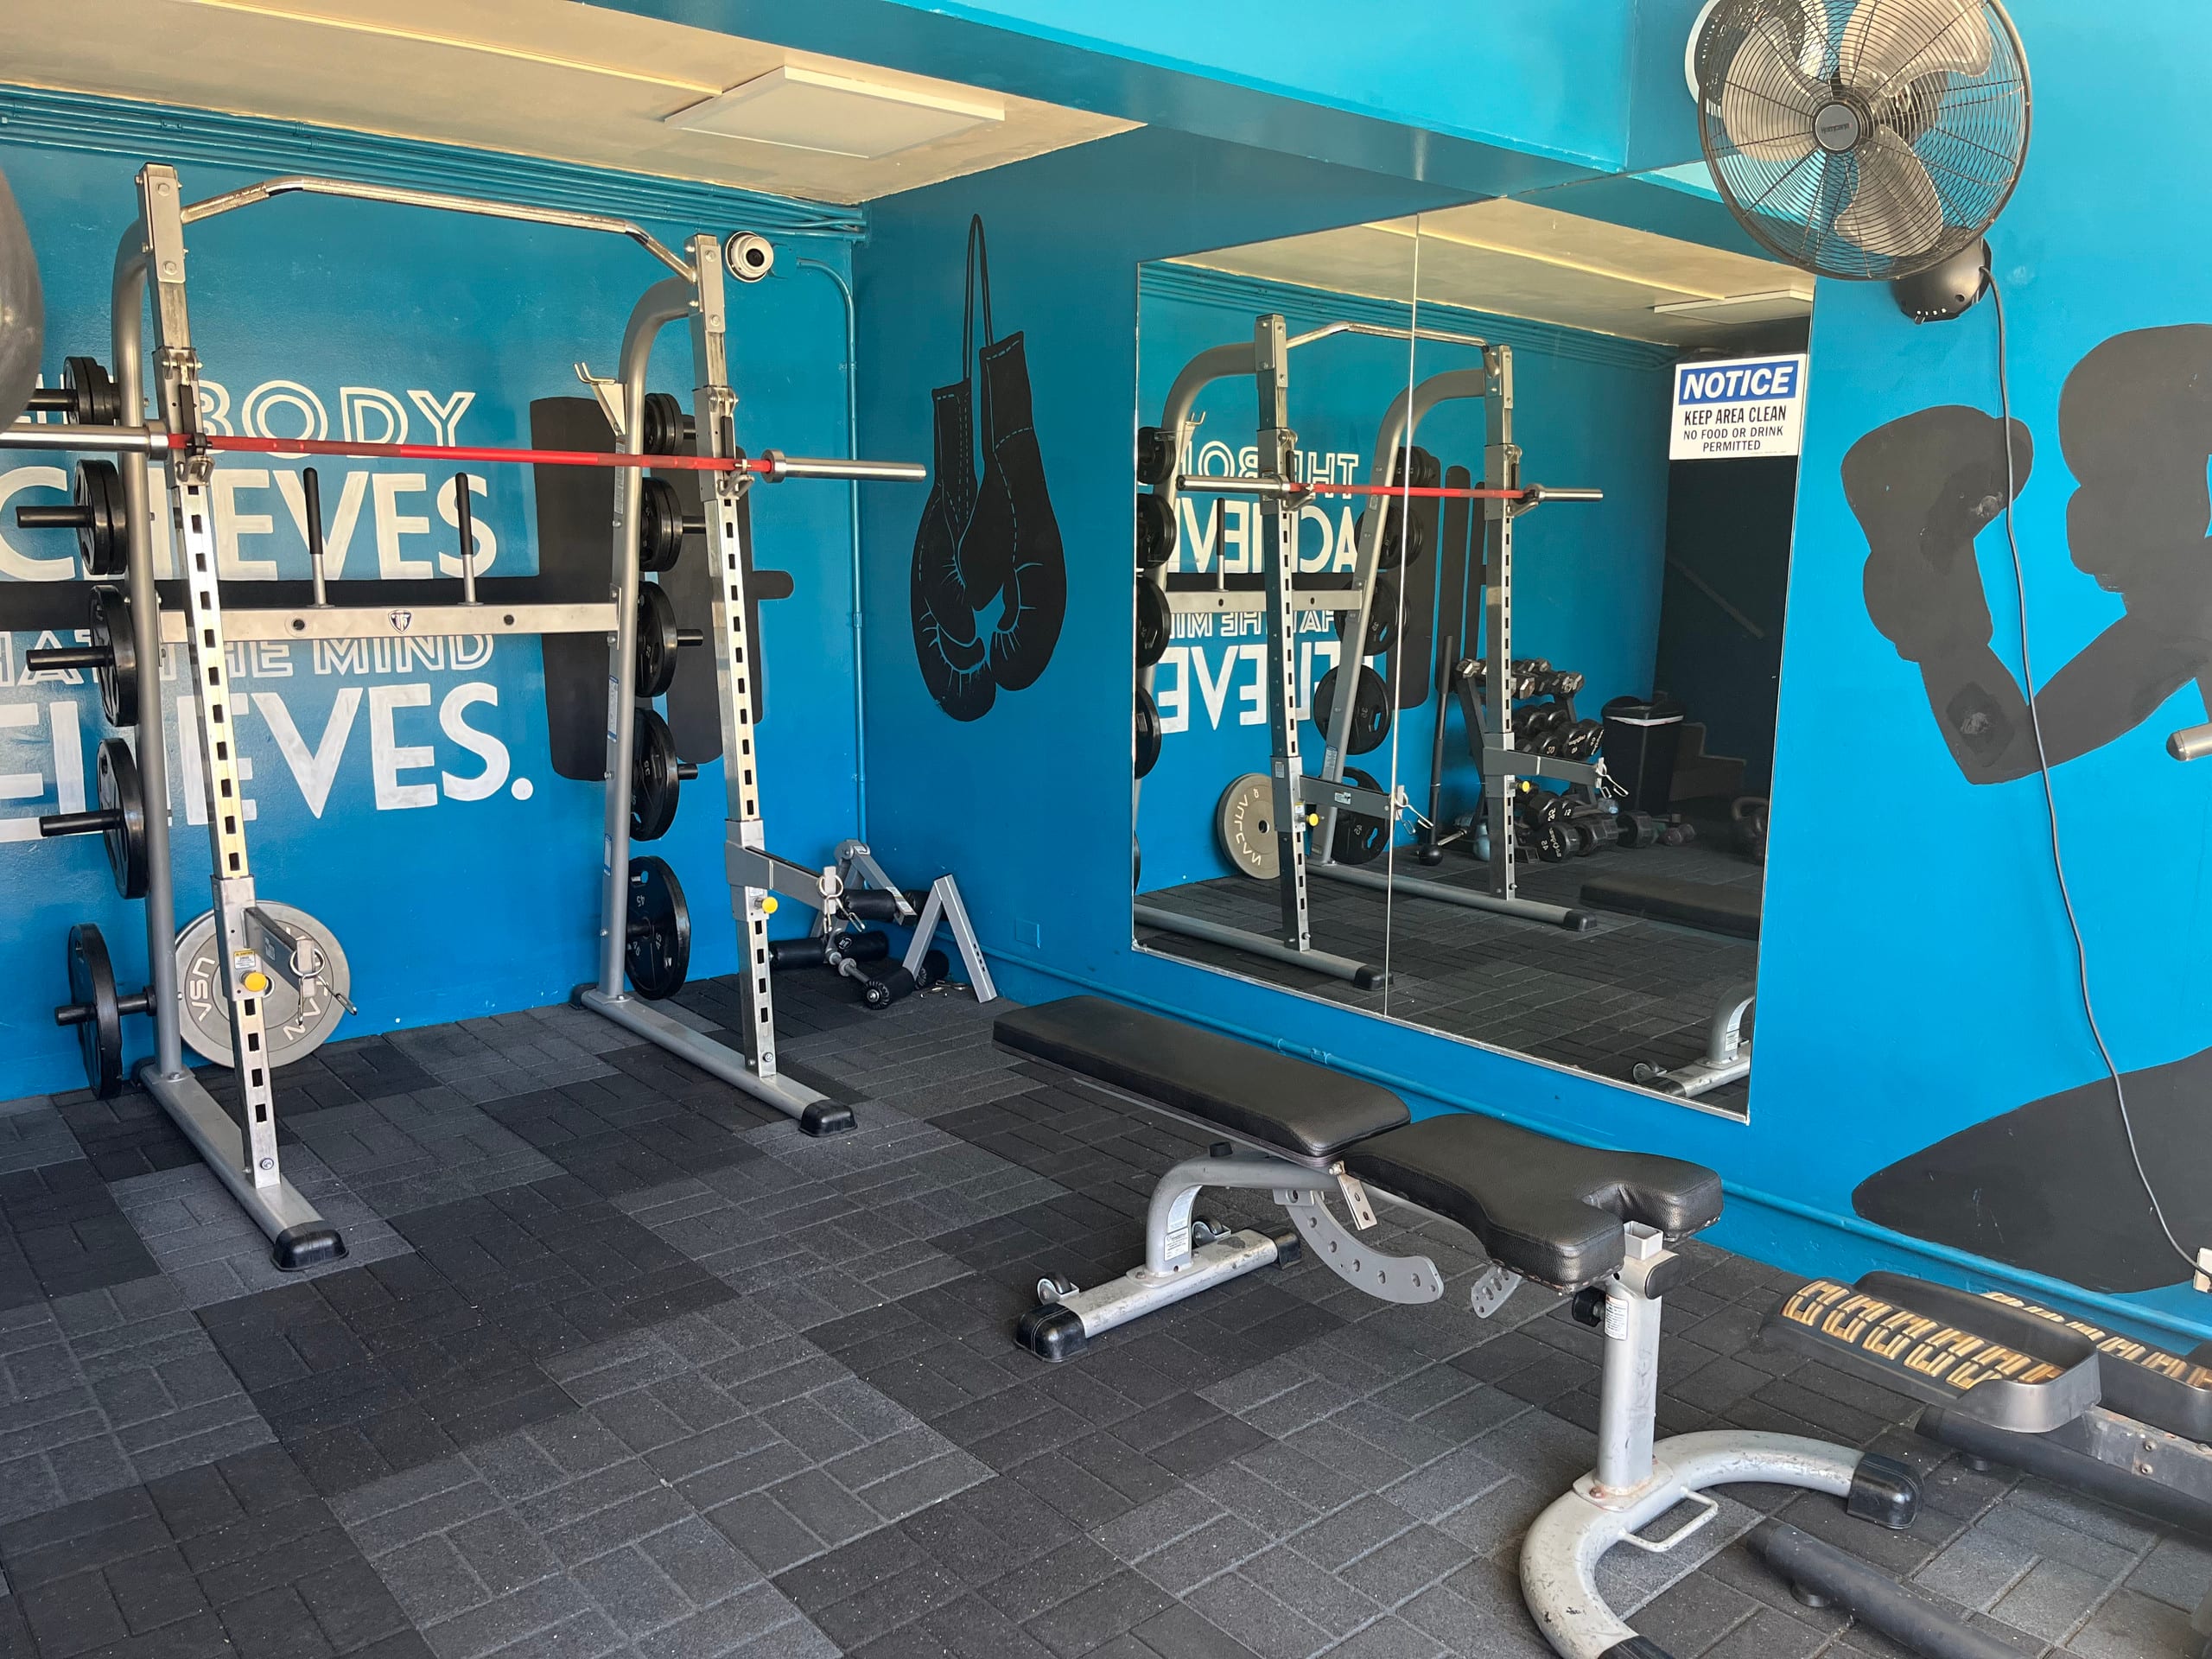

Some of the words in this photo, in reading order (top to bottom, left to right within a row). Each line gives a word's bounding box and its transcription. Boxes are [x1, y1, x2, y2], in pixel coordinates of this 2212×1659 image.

[1683, 366, 1794, 400] NOTICE
[1684, 410, 1713, 426] KEEP
[1715, 408, 1745, 424] AREA
[1749, 405, 1787, 423] CLEAN
[1683, 429, 1698, 440] NO
[1701, 429, 1728, 439] FOOD
[1732, 428, 1746, 438] OR
[1751, 426, 1783, 437] DRINK
[1703, 440, 1761, 452] PERMITTED
[313, 635, 494, 676] MIND
[636, 894, 645, 907] 45
[189, 957, 216, 1022] USA
